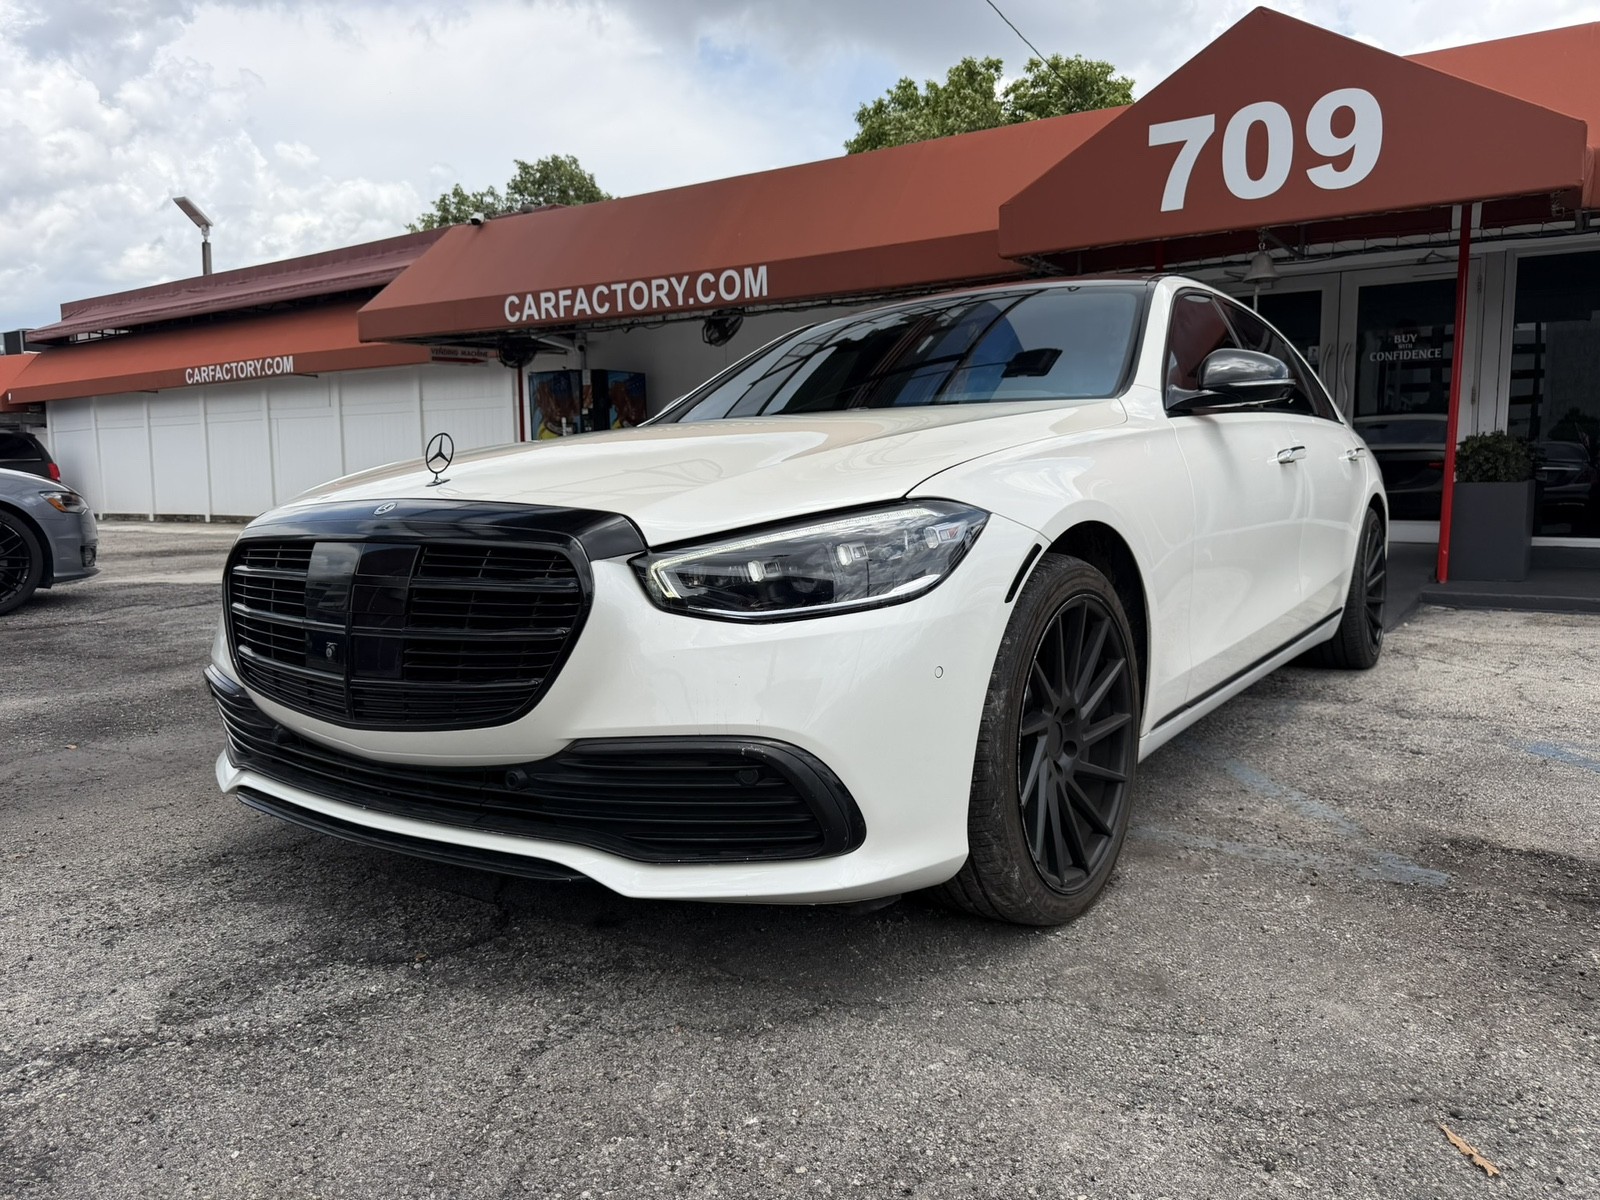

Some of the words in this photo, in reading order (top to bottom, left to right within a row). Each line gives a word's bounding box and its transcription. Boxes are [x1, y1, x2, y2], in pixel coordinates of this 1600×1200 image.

[1148, 87, 1383, 212] 709
[504, 265, 768, 323] CARFACTORY.COM
[1394, 334, 1417, 344] BUY
[1369, 348, 1442, 362] CONFIDENCE
[185, 356, 294, 384] CARFACTORY.COM
